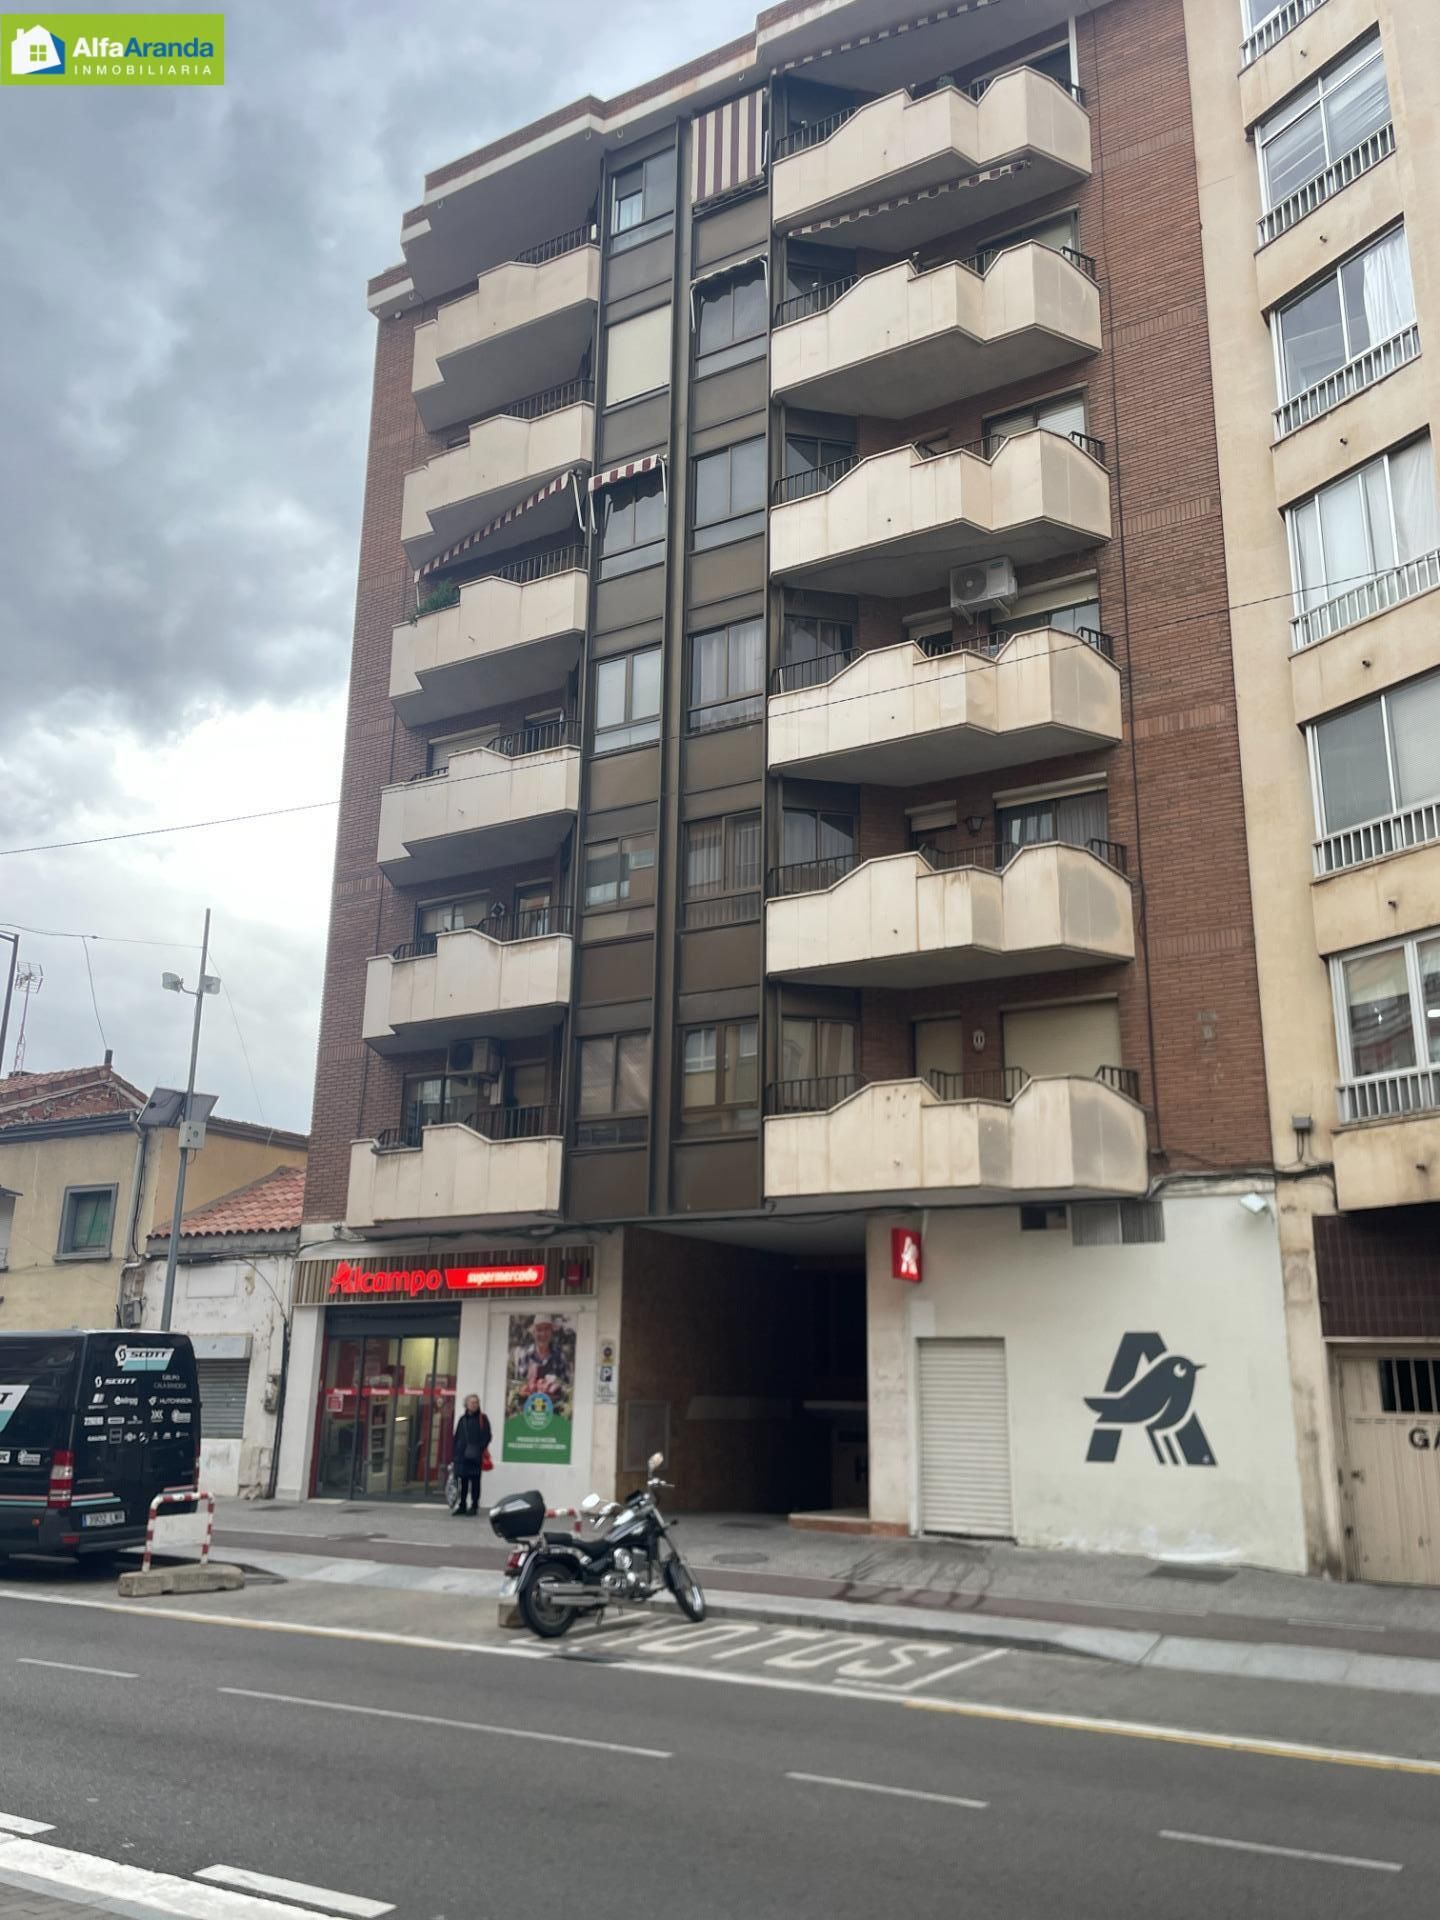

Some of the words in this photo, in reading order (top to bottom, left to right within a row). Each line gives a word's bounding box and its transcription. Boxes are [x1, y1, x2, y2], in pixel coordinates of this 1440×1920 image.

[329, 1260, 442, 1296] Alcampo
[129, 1350, 169, 1358] SCOTT
[104, 1377, 137, 1385] SCOTT
